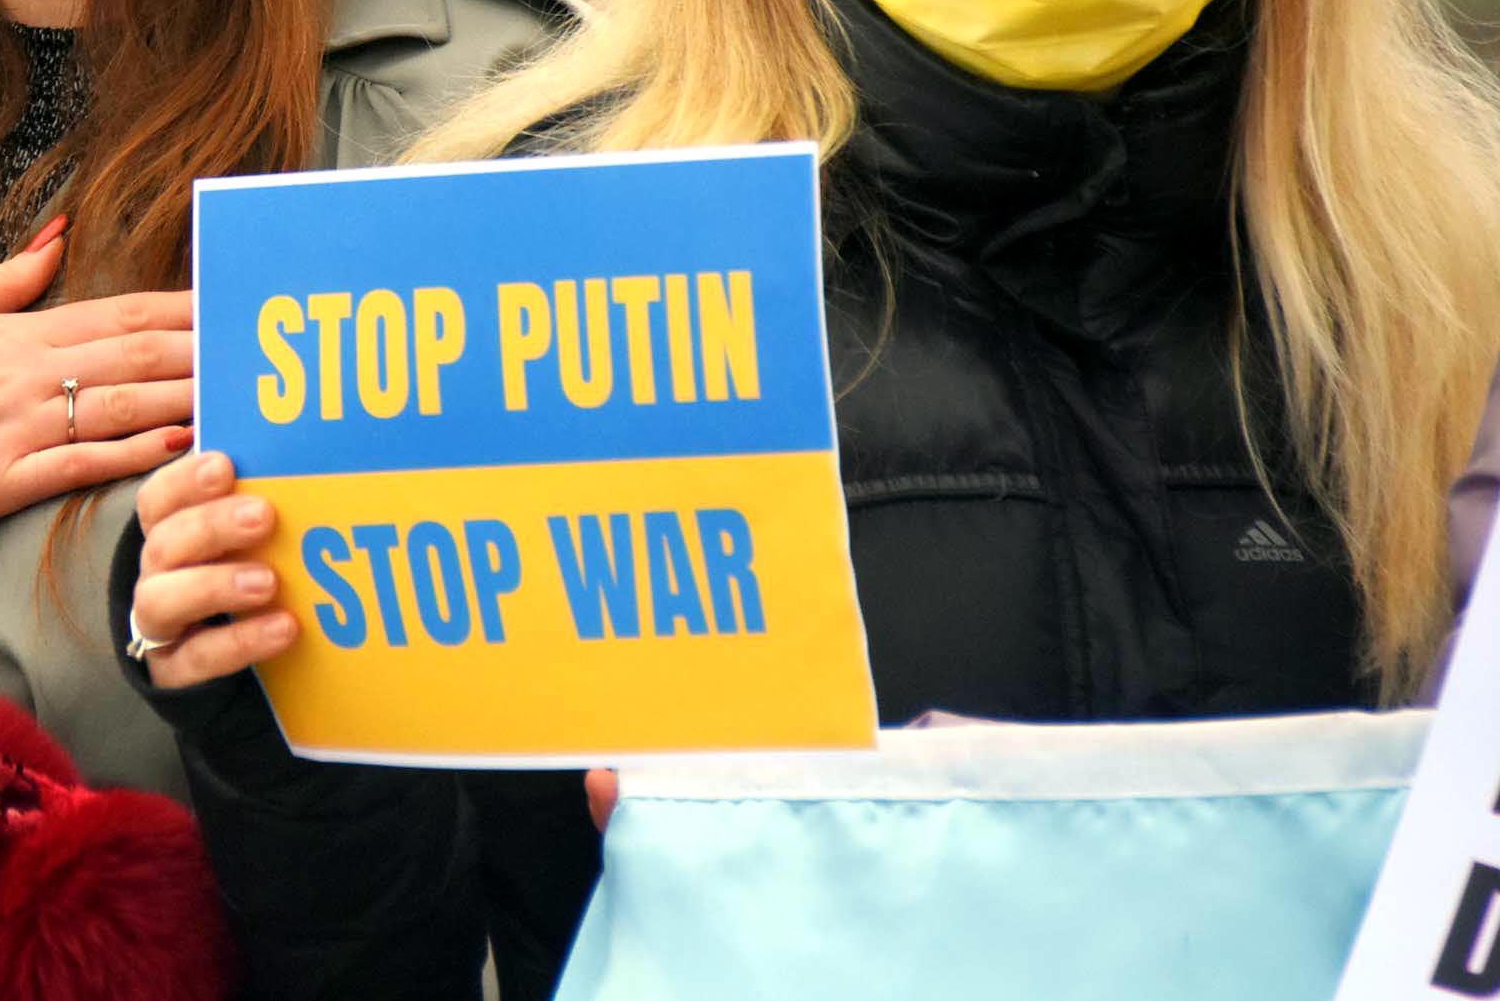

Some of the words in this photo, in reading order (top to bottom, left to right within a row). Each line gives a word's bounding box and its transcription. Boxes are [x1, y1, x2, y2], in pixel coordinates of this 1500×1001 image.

[257, 287, 466, 424] STOP
[497, 270, 760, 411] PUTIN
[302, 519, 522, 648] STOP
[547, 508, 766, 639] WAR
